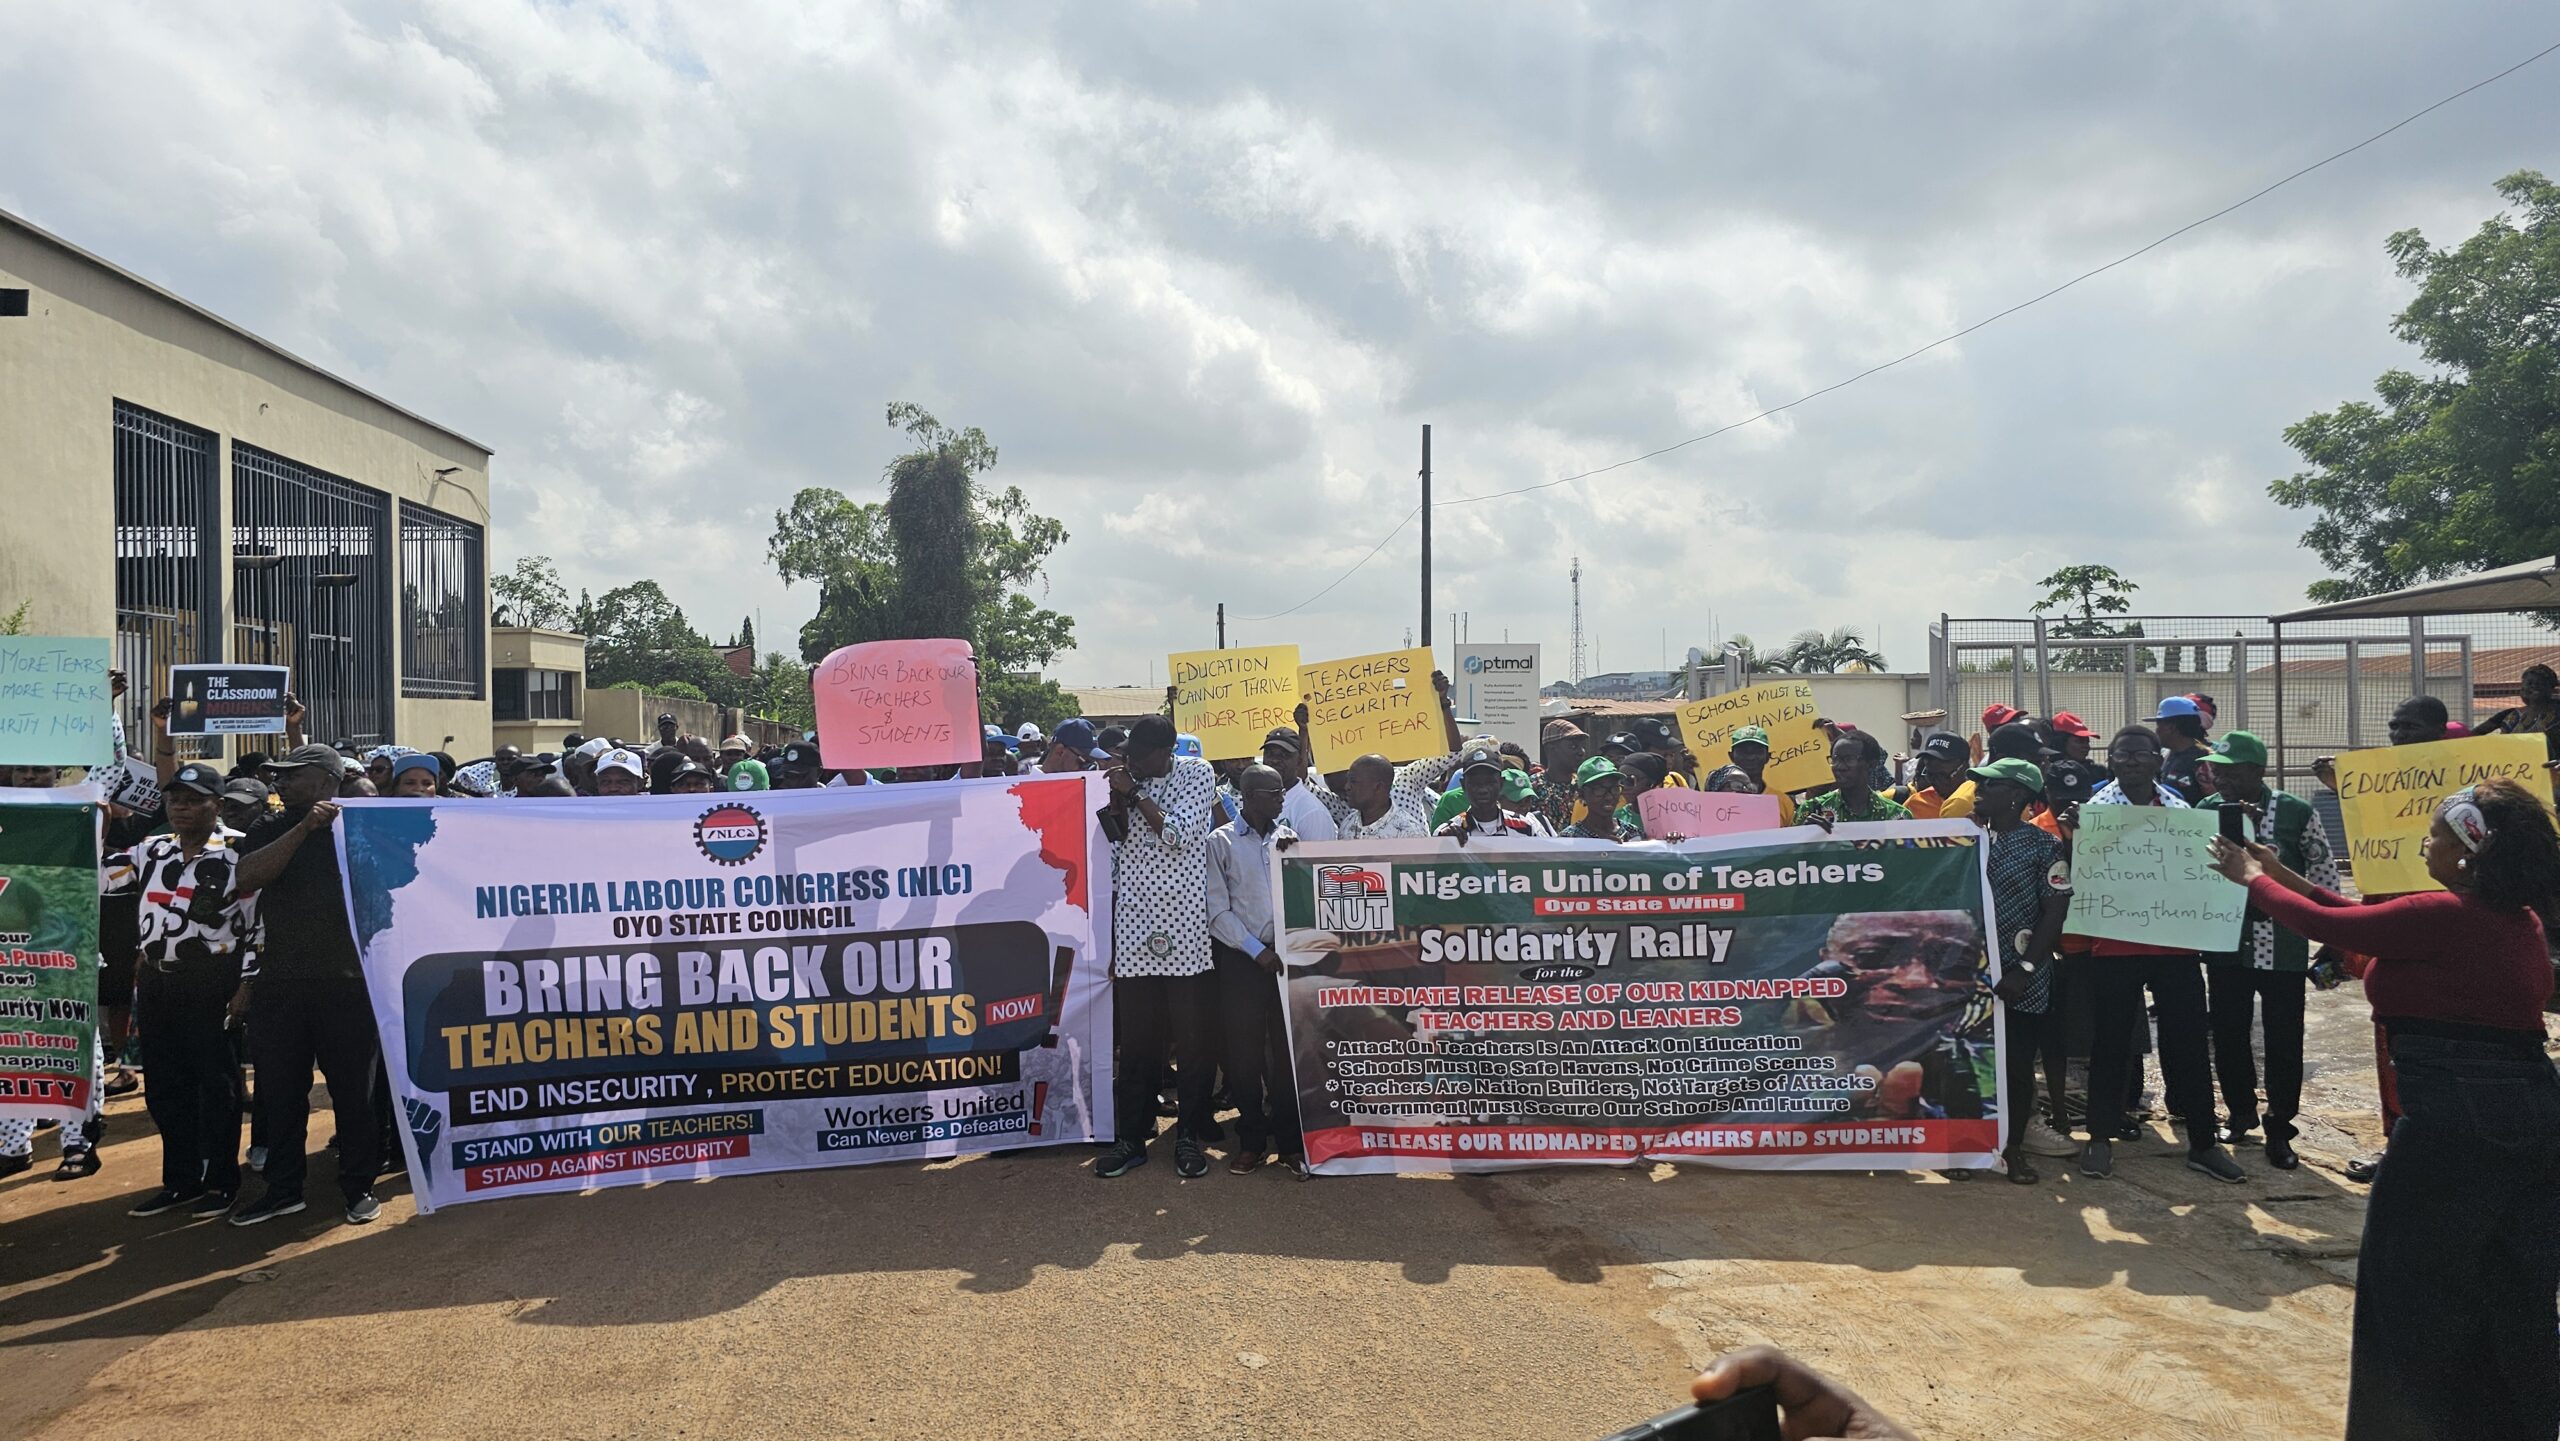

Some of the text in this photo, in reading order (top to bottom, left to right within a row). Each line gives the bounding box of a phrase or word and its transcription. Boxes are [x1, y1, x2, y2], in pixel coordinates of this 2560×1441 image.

[1, 649, 104, 674] MORE TEARS
[830, 654, 969, 685] BRING BACK OUR
[1176, 656, 1268, 684] EDUCATION
[1304, 657, 1411, 689] TEACHERS
[2, 682, 105, 702] MORE FEAR
[207, 676, 229, 688] THE
[207, 688, 277, 700] CLASSROOM
[1178, 677, 1293, 706] CANNOT THRIVE
[1314, 679, 1394, 705] DESERVE
[206, 701, 272, 715] MOURNS
[850, 687, 932, 709] TEACHERS
[1315, 691, 1413, 726] SECURITY
[1686, 686, 1811, 724] SCHOOLS MUST BE
[50, 712, 94, 736] NOW
[1185, 709, 1240, 733] UNDER
[1330, 712, 1431, 750] NOT FEAR
[1697, 703, 1814, 748] SAFE HAVENS
[858, 724, 951, 745] STUDENTS
[1769, 739, 1821, 768] SCENES
[134, 785, 147, 795] TO
[139, 776, 154, 788] WE
[2341, 766, 2446, 800] EDUCATION
[128, 794, 140, 803] IN
[1645, 795, 1741, 822] ENOUGH OF
[2395, 796, 2438, 818] ATT
[718, 827, 745, 839] NLC
[2086, 812, 2203, 837] Their Silence
[2077, 838, 2193, 863] Captivity is
[2353, 837, 2405, 861] MUST
[1400, 860, 1884, 900] Nigeria Union of Teachers
[2078, 862, 2168, 882] National
[2184, 864, 2227, 883] Sha
[476, 863, 972, 918] NIGERIA LABOUR CONGRESS (NLC)
[1319, 898, 1389, 931] NUT
[1545, 896, 1734, 913] Oyo State Wing
[613, 906, 855, 939] OYO STATE COUNCIL
[1421, 927, 1617, 966] Solidarity
[1630, 924, 1733, 963] Rally
[12, 949, 78, 969] Pupils
[483, 936, 952, 1016] BRING BACK OUR
[1532, 966, 1583, 982] for the
[1319, 977, 1847, 1008] IMMEDIATE RELEASE OF OUR KIDNAPPED
[47, 998, 91, 1022] NOW!
[1420, 1006, 1742, 1031] TEACHERS AND LEANERS
[24, 1031, 79, 1050] Terror
[441, 993, 1035, 1070] TEACHERS AND STUDENTS NOW
[1337, 1035, 1802, 1056] Attack On Teachers Is An Attack On Education
[1339, 1055, 1836, 1077] Schools Must Be Safe Havens, Not Crime Scenes
[470, 1090, 529, 1115] END
[538, 1073, 698, 1107] INSECURITY
[721, 1066, 840, 1093] PROTECT
[849, 1055, 1002, 1087] EDUCATION!
[1342, 1074, 1875, 1099] Teachers Are Nation Builders, Not Targets of Attacks
[825, 1090, 1025, 1129] Workers United
[1342, 1097, 1850, 1116] Government Must Secure Our Schools And Future
[464, 1113, 753, 1163] STAND WITH OUR TEACHERS!
[827, 1114, 1026, 1149] Can Never Be Defeated
[1361, 1126, 1925, 1151] RELEASE OUR KIDNAPPED TEACHERS AND STUDENTS
[482, 1140, 734, 1185] STAND AGAINST INSECURITY
